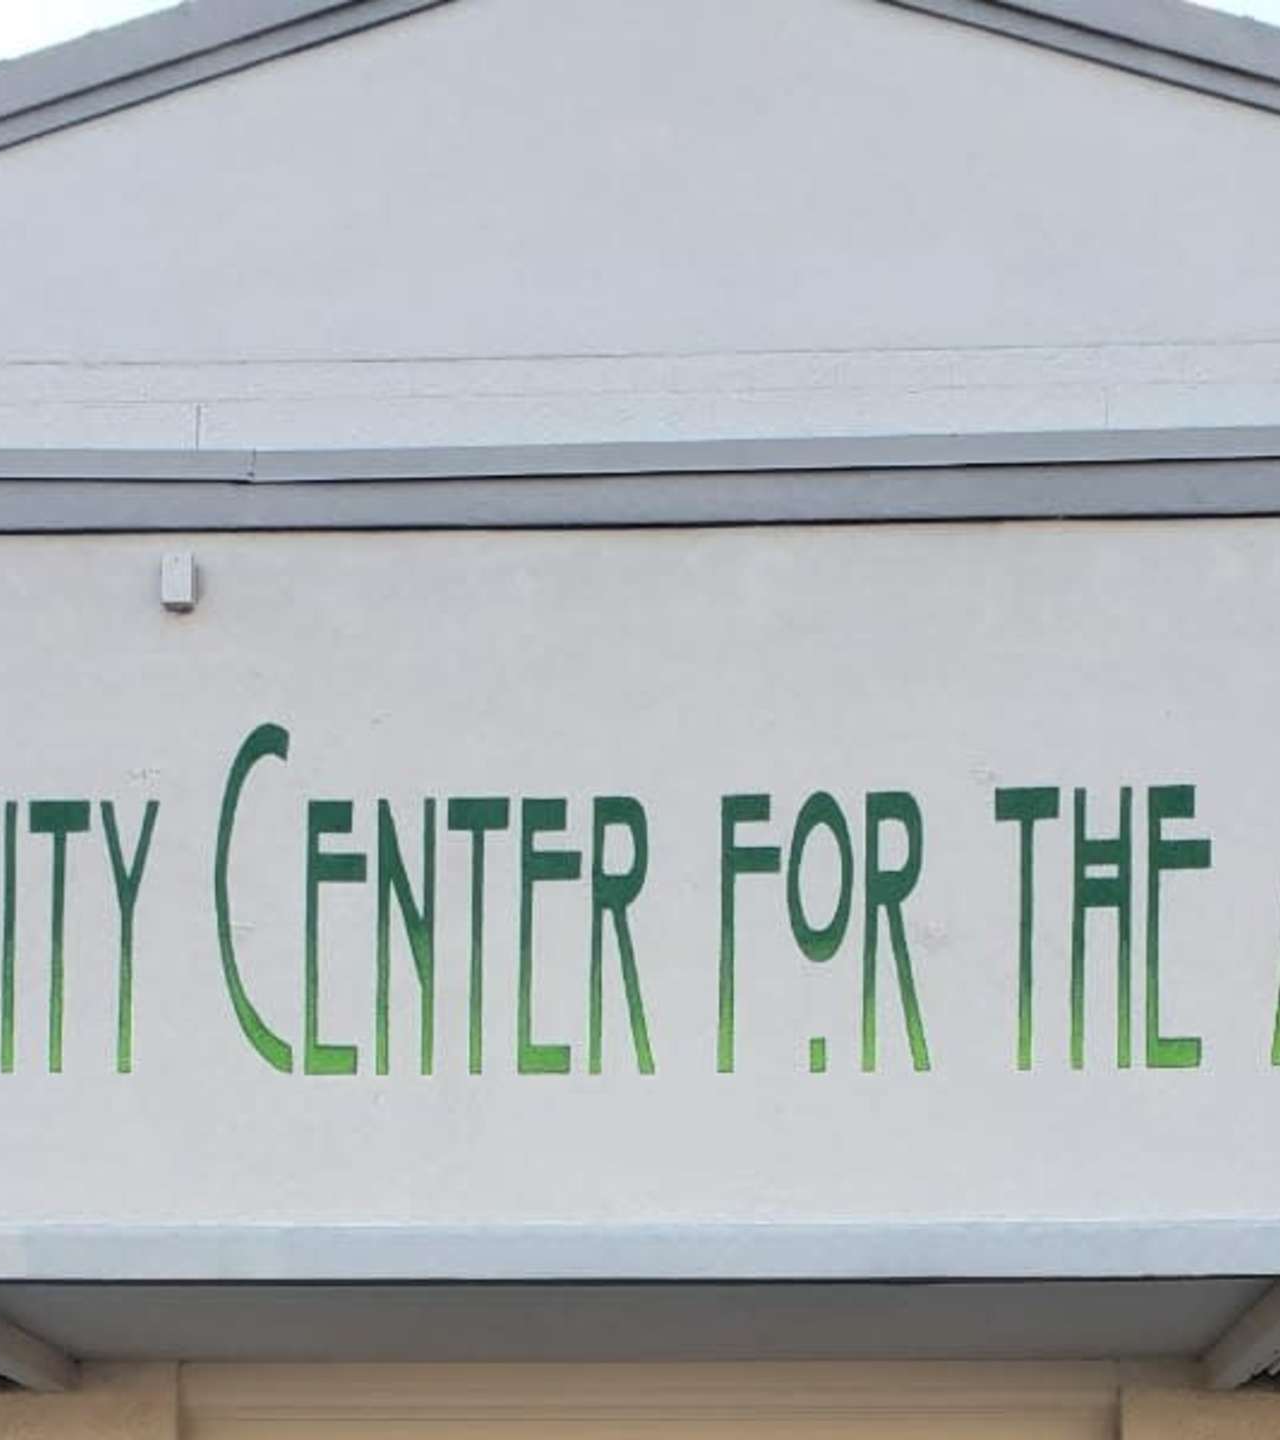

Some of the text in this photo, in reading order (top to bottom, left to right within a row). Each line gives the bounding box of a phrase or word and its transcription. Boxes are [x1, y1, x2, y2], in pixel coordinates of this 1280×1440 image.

[215, 724, 653, 1074] CENTER
[719, 791, 929, 1073] FOR
[996, 784, 1211, 1070] THE
